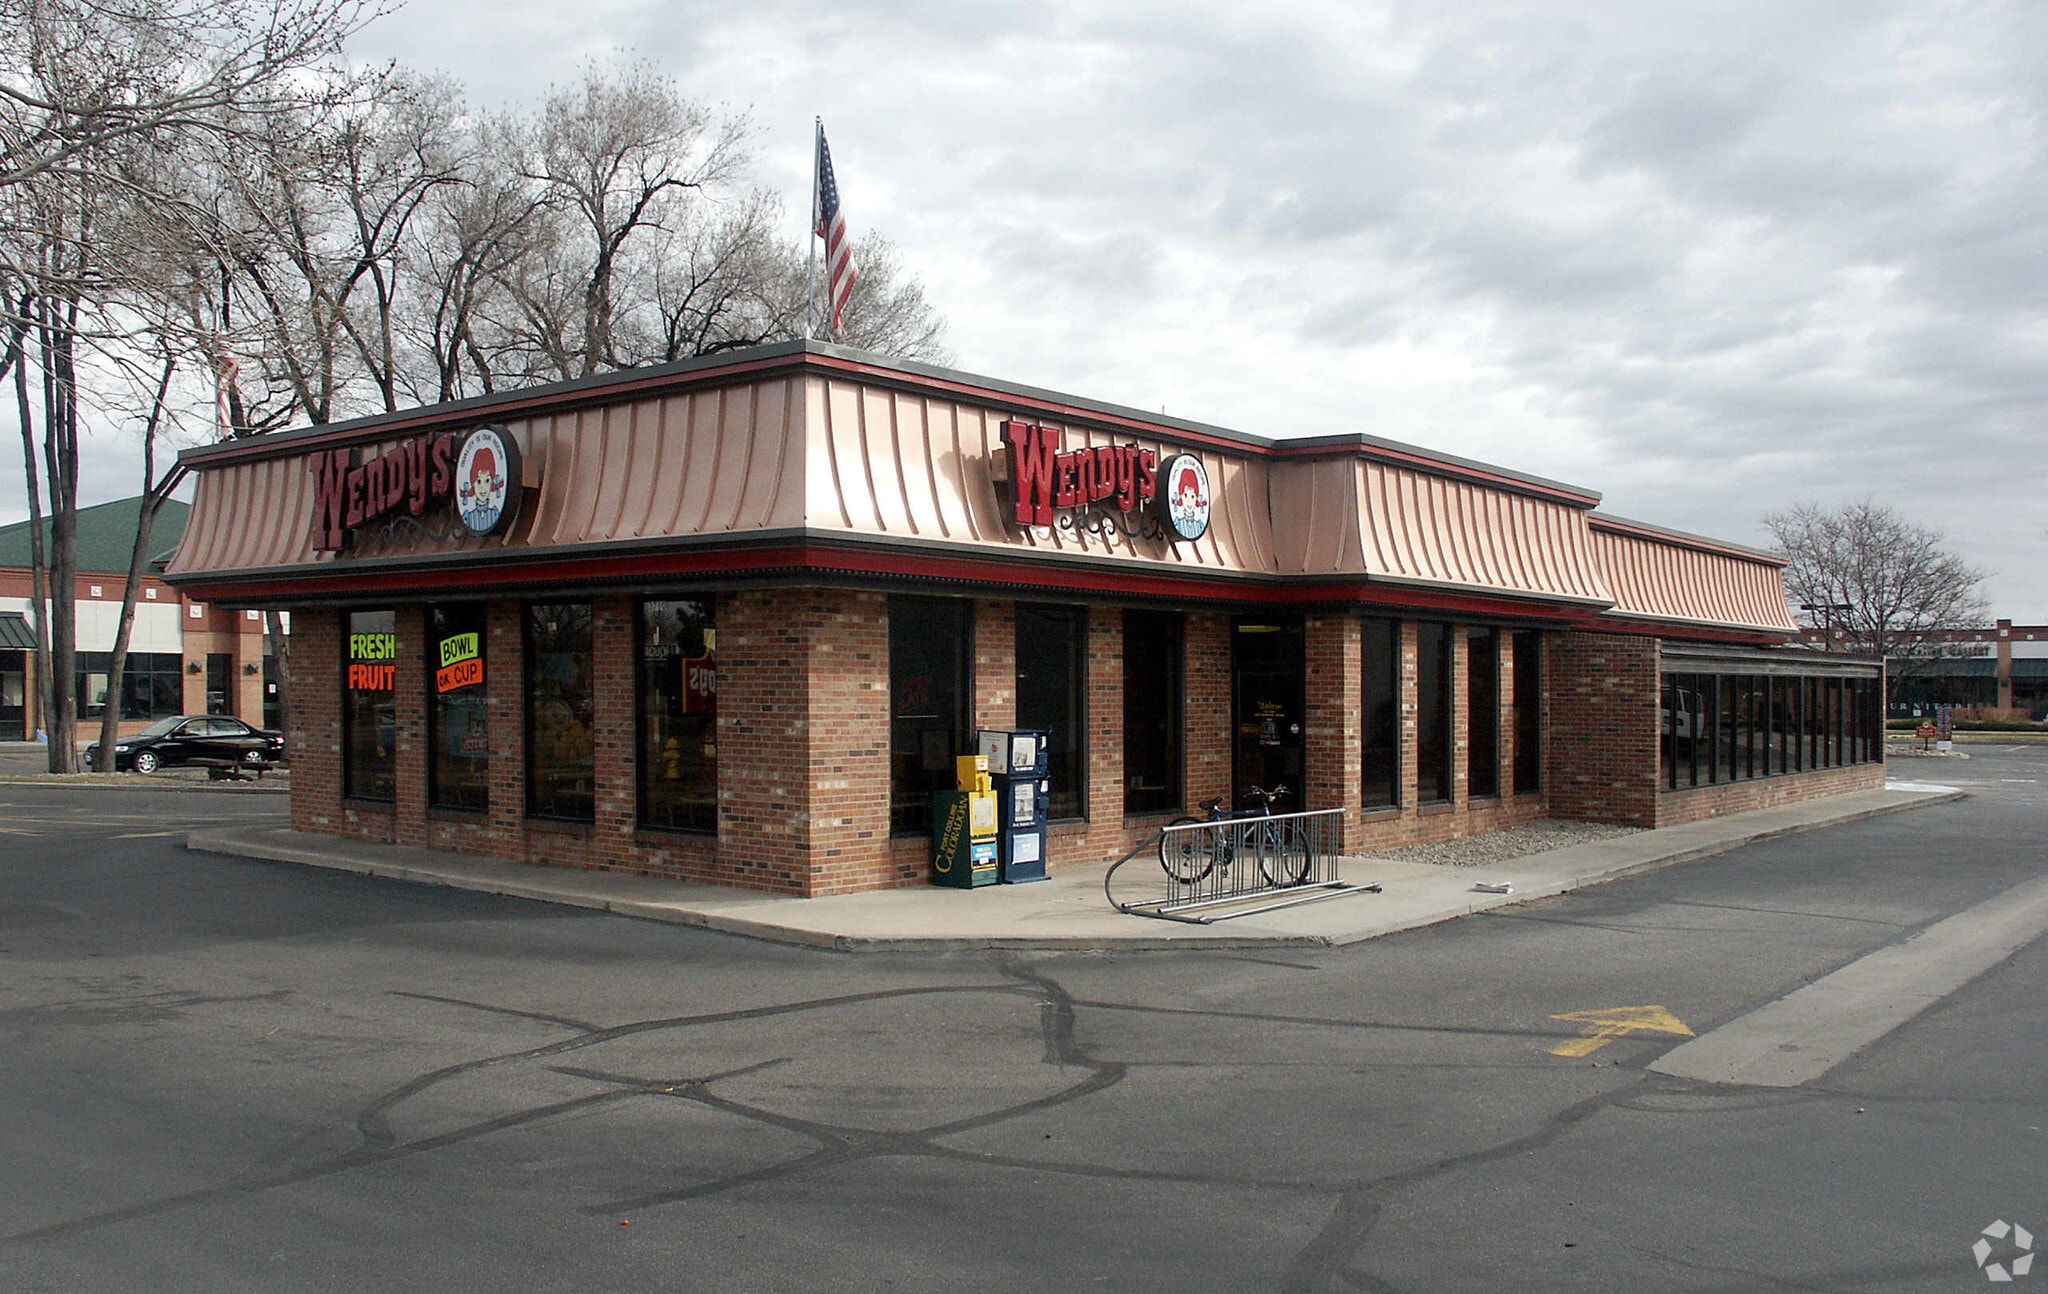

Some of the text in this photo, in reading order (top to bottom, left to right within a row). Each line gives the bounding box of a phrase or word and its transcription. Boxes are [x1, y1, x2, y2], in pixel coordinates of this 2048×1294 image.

[1005, 420, 1156, 526] Wendy's
[310, 432, 453, 551] Wendy's
[350, 633, 395, 659] FRESH
[442, 636, 474, 662] BOWL
[349, 664, 395, 690] FRUIT
[439, 663, 478, 687] OR CUP
[1889, 702, 1974, 710] URNITRE
